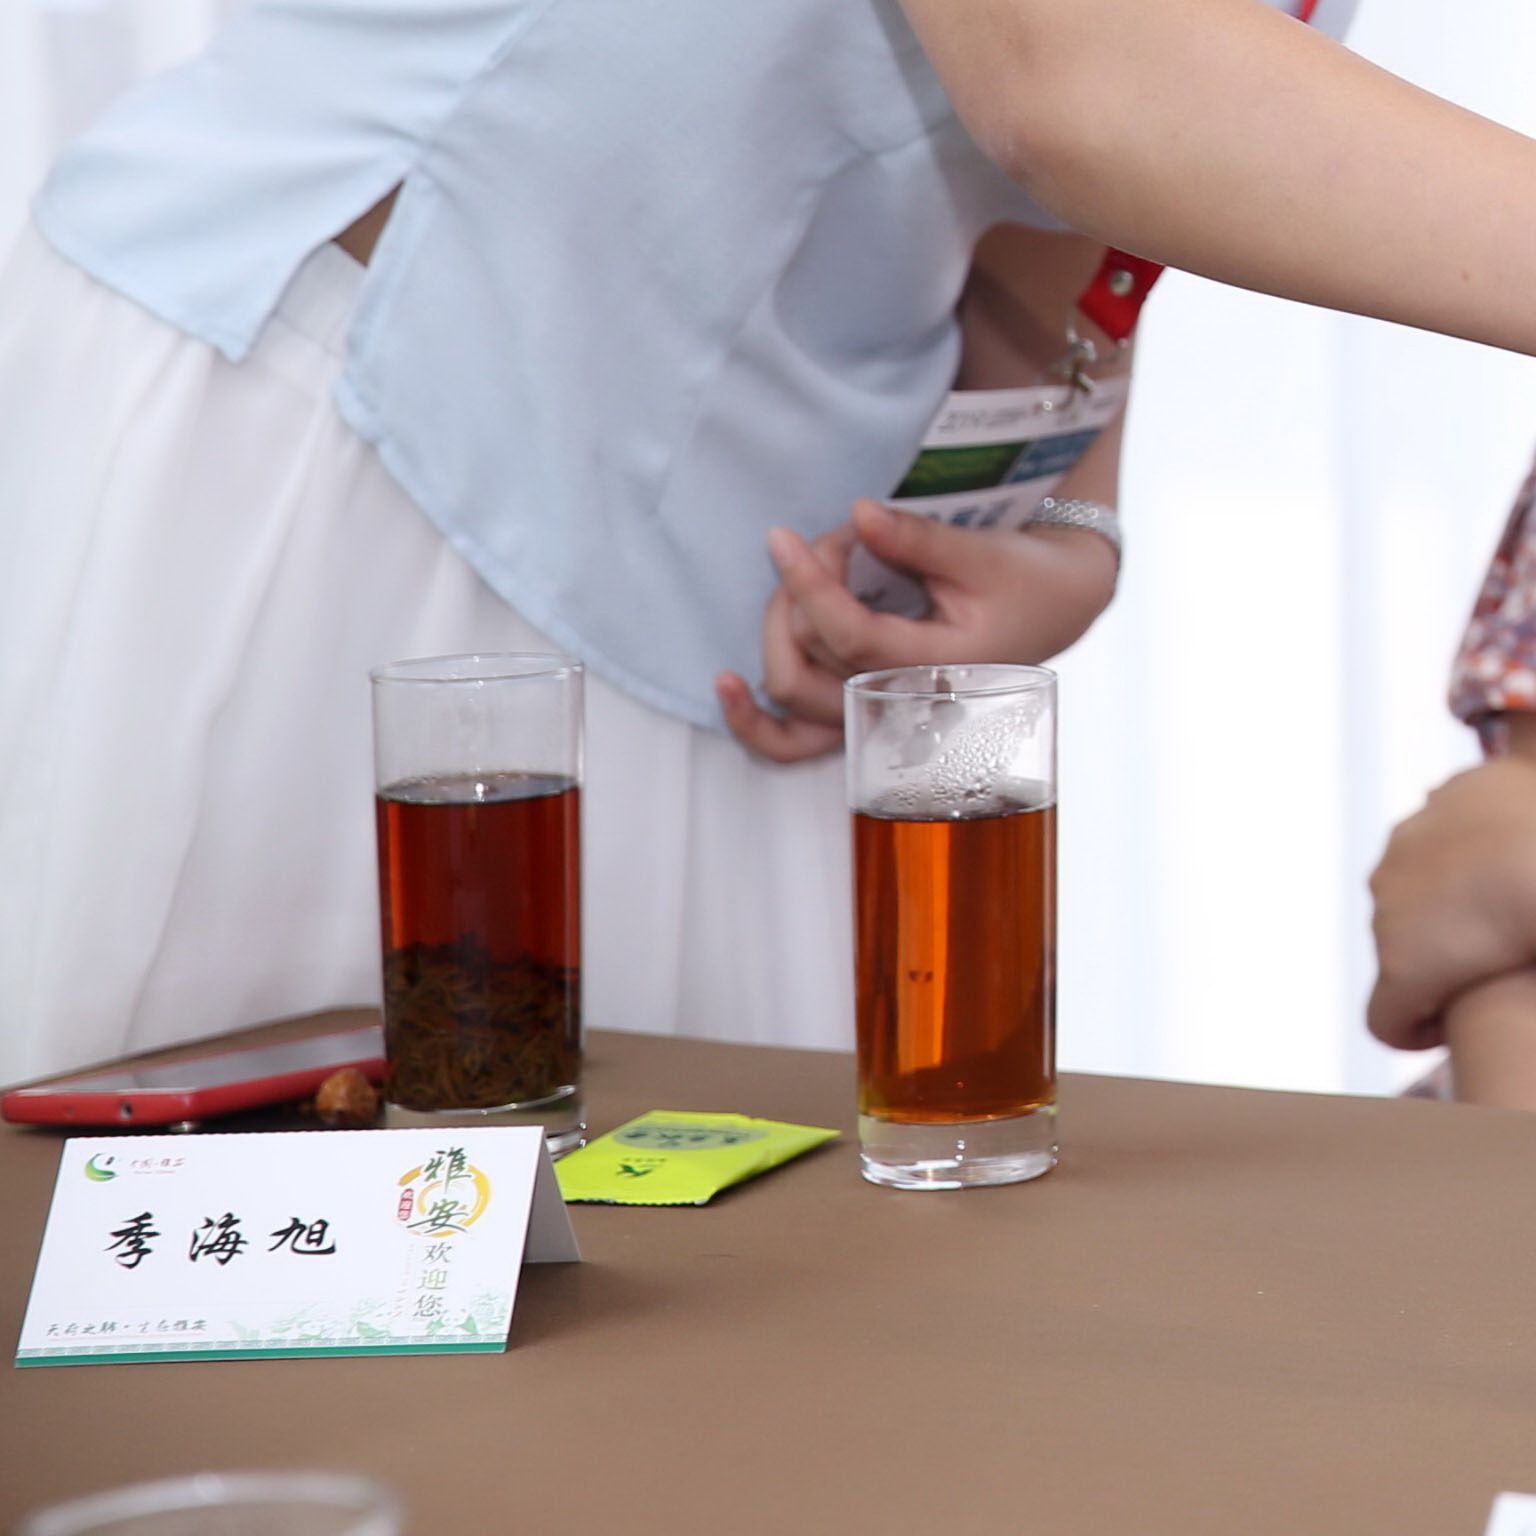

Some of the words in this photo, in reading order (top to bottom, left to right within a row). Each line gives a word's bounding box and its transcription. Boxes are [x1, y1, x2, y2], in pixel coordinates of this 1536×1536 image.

[406, 1146, 471, 1234] 雅安
[104, 1212, 336, 1270] 季海旭
[413, 1242, 453, 1318] 欢迎您
